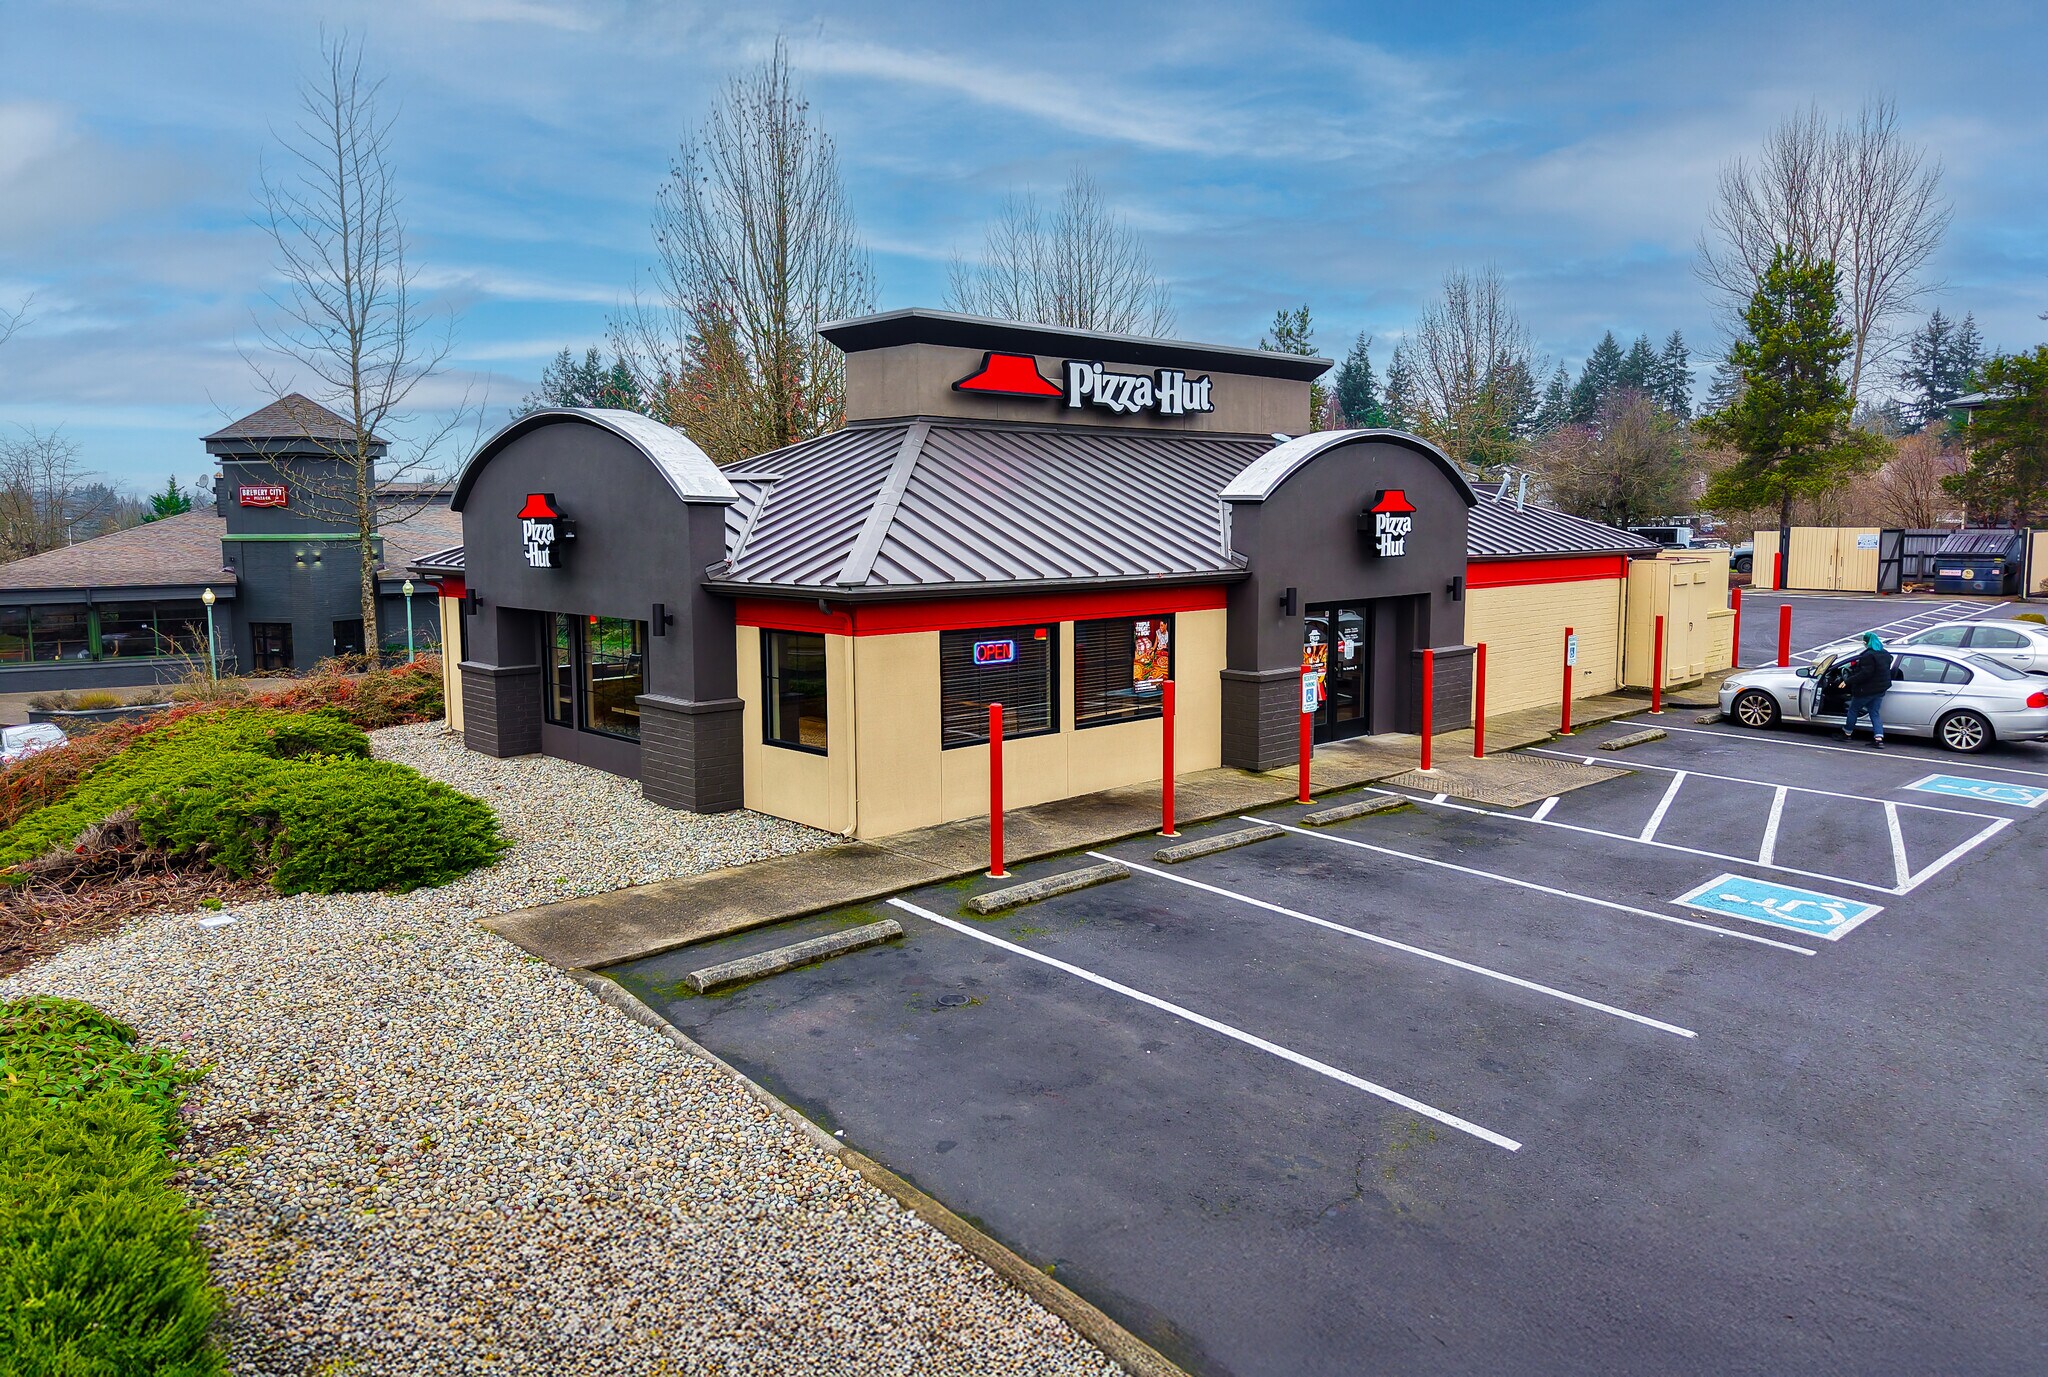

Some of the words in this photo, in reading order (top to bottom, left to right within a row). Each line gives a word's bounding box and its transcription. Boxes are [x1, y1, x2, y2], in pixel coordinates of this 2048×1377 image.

[1068, 362, 1154, 413] Pizza
[522, 518, 555, 545] Pizza
[1375, 512, 1412, 537] Pizza
[524, 541, 552, 567] Hut
[1376, 534, 1405, 556] Hut
[976, 643, 1012, 661] OPEN
